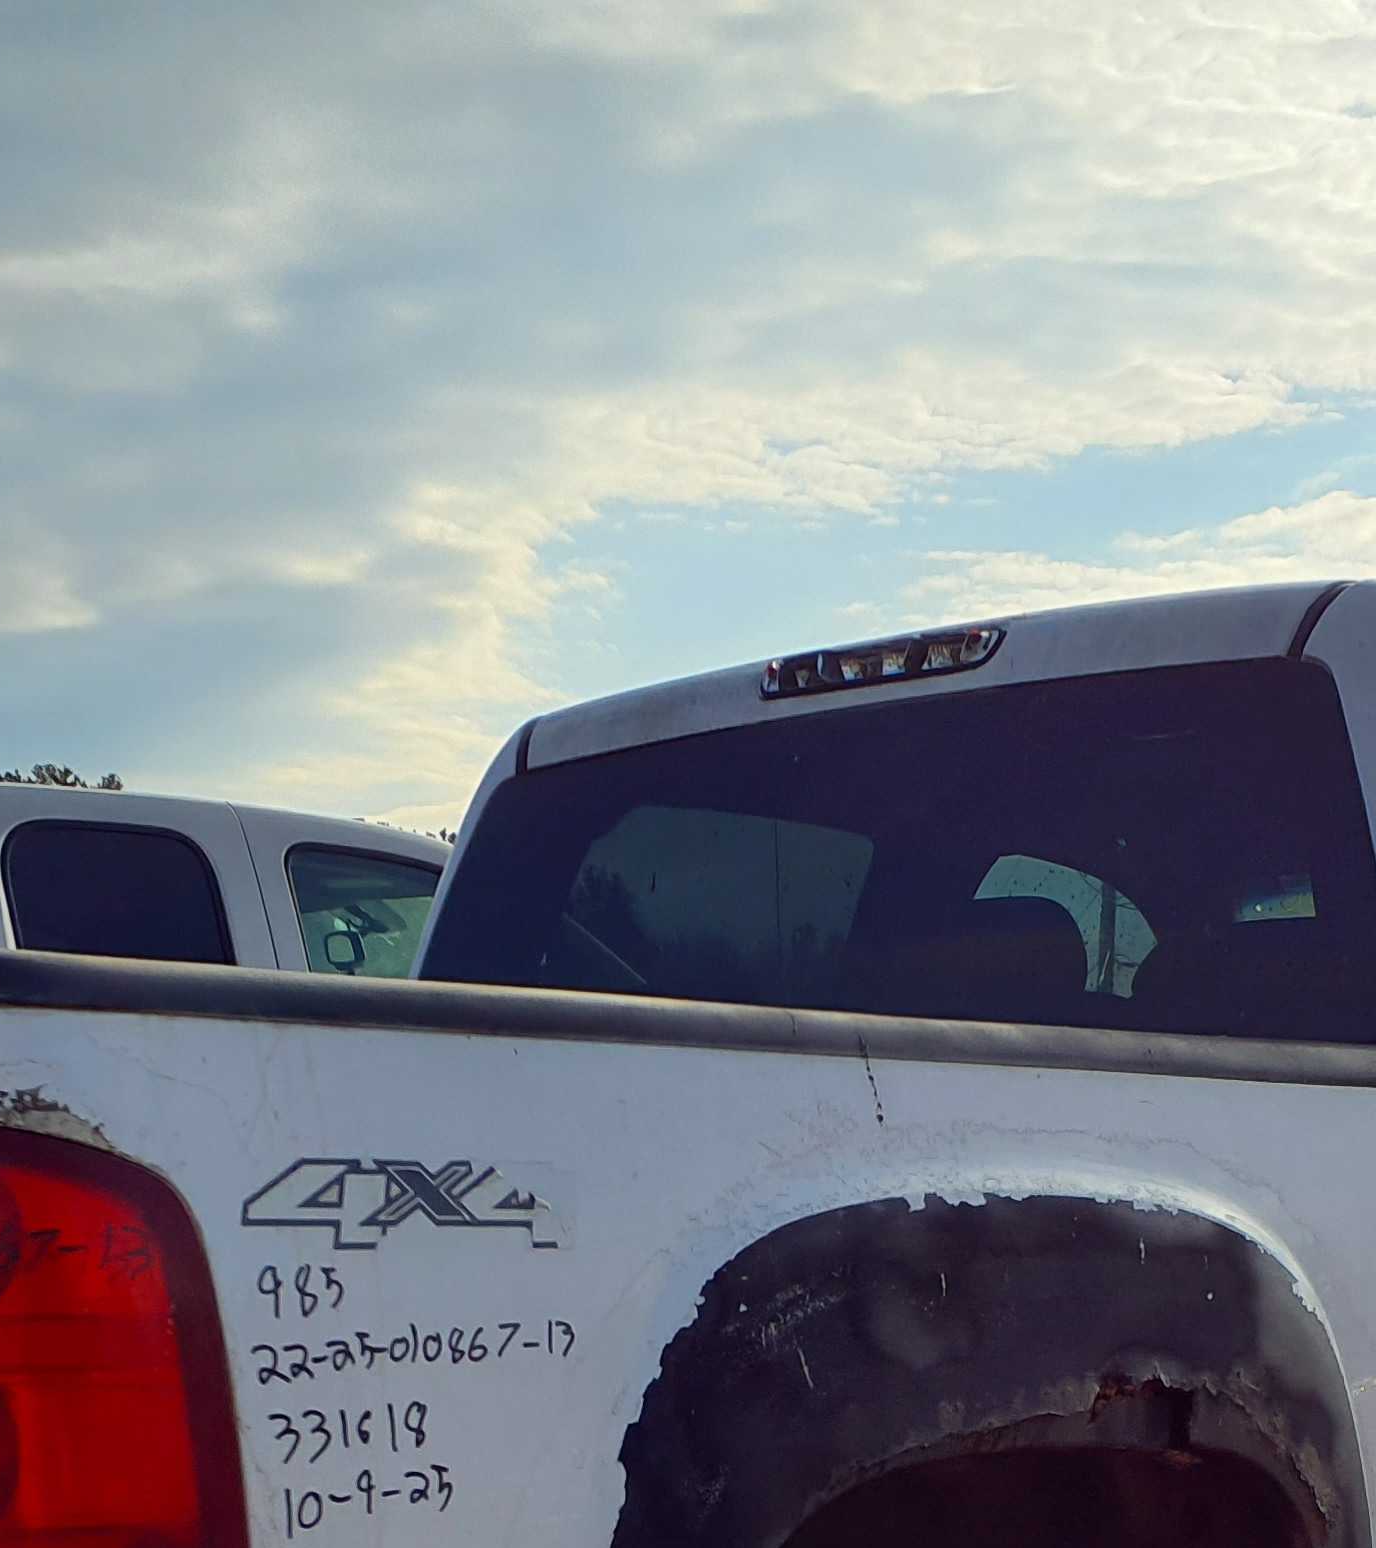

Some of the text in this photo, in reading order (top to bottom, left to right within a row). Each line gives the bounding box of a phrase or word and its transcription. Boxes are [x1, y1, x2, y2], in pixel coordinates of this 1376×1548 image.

[257, 1263, 345, 1319] 985
[251, 1320, 576, 1386] 22-25-010867-13
[267, 1400, 429, 1464] 331618
[284, 1464, 454, 1540] 10-9-25
